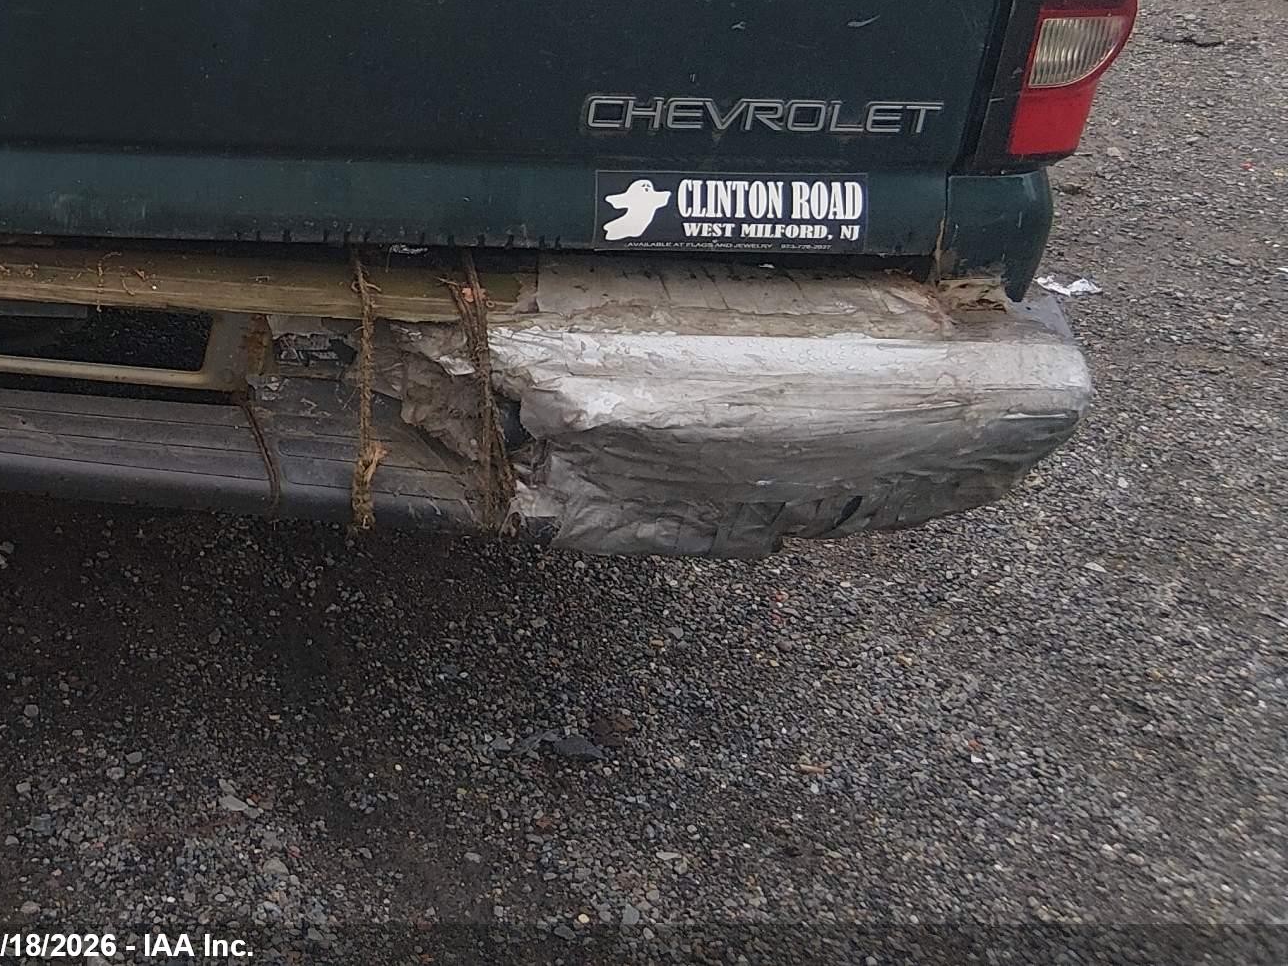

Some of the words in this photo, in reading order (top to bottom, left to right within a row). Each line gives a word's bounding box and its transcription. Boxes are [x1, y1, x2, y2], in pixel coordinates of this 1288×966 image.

[587, 96, 944, 135] CHEVROLET
[678, 179, 783, 218] CLINTON
[791, 181, 863, 220] ROAD
[683, 223, 735, 237] WEST
[740, 223, 833, 240] MILFORD,
[840, 224, 860, 240] NJ
